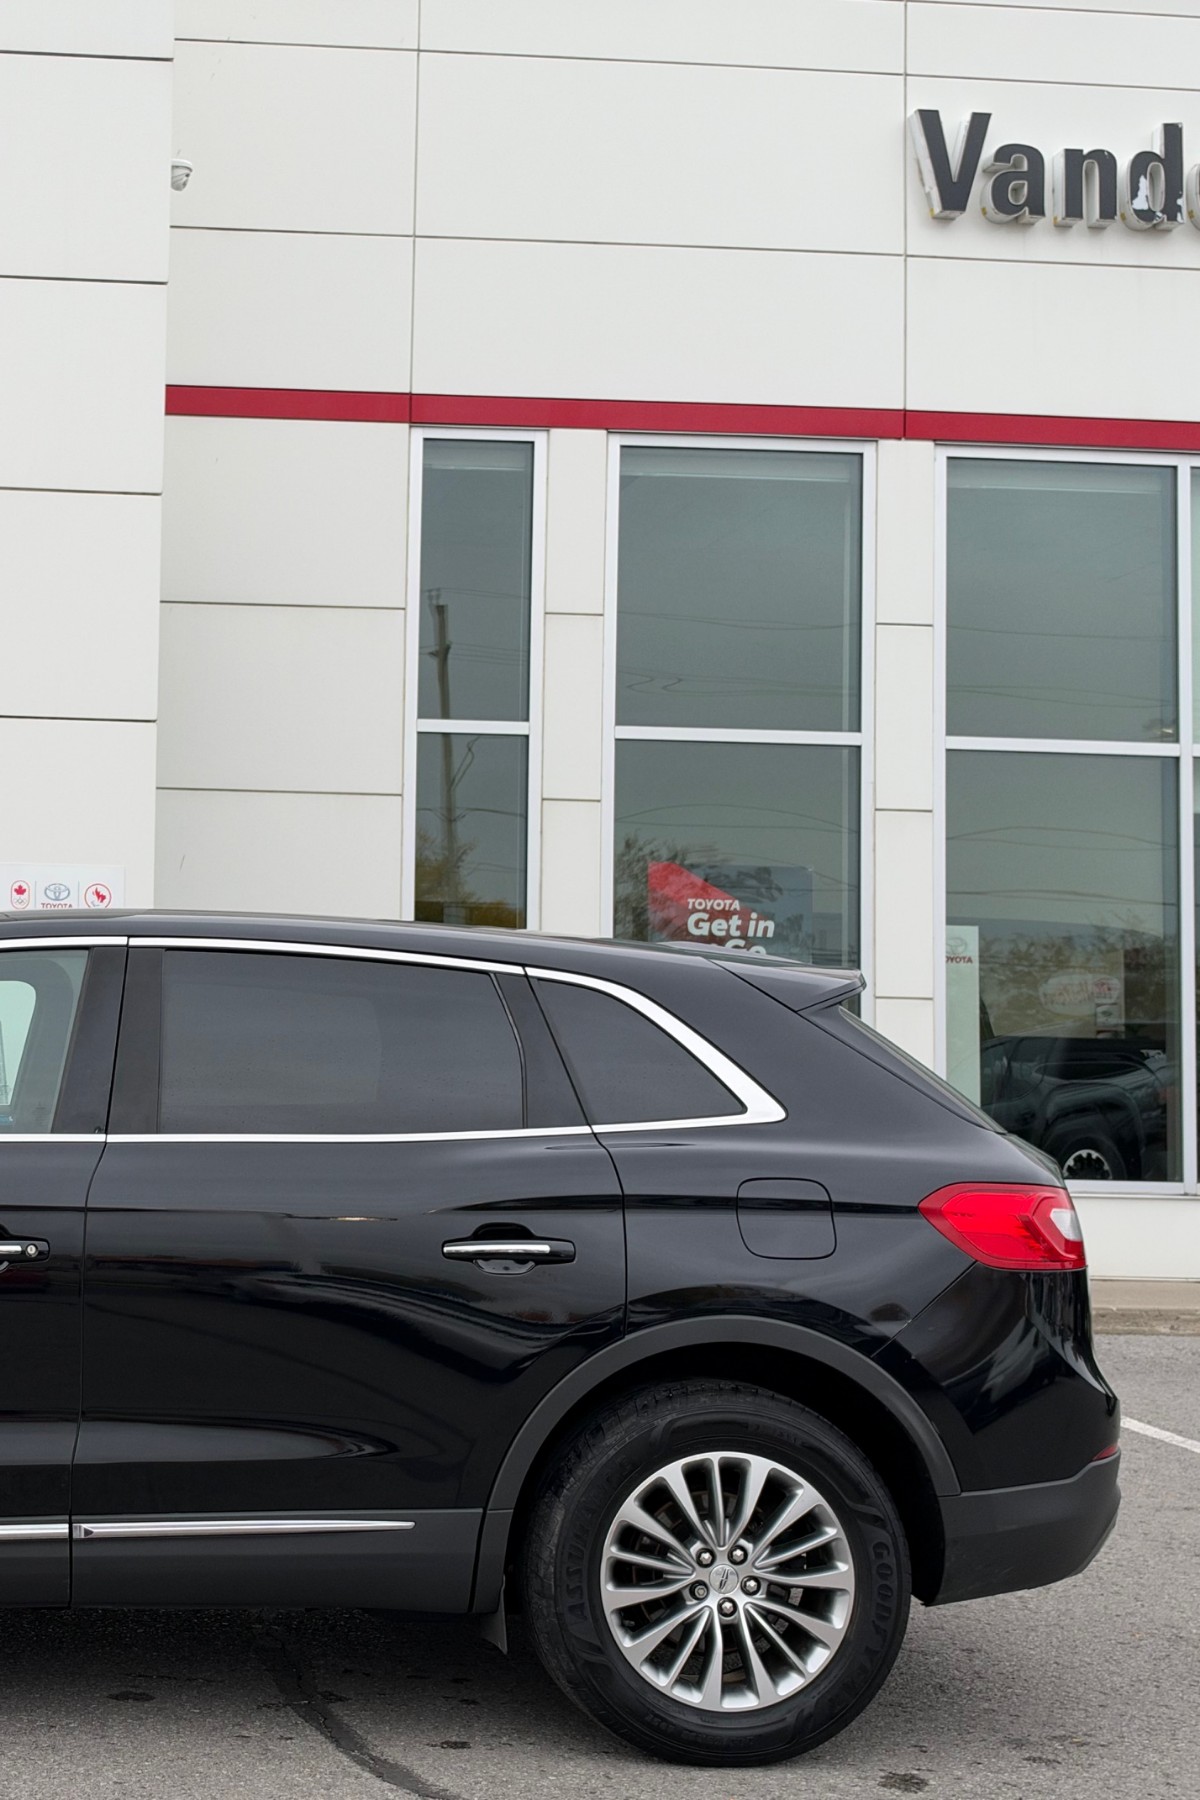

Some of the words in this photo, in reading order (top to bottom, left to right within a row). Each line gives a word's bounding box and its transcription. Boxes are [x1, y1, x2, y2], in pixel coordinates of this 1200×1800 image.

[909, 107, 1200, 232] Vand
[687, 898, 741, 911] TOYOTA
[687, 911, 742, 937] Get
[746, 911, 775, 938] in
[945, 955, 973, 964] OYOTA
